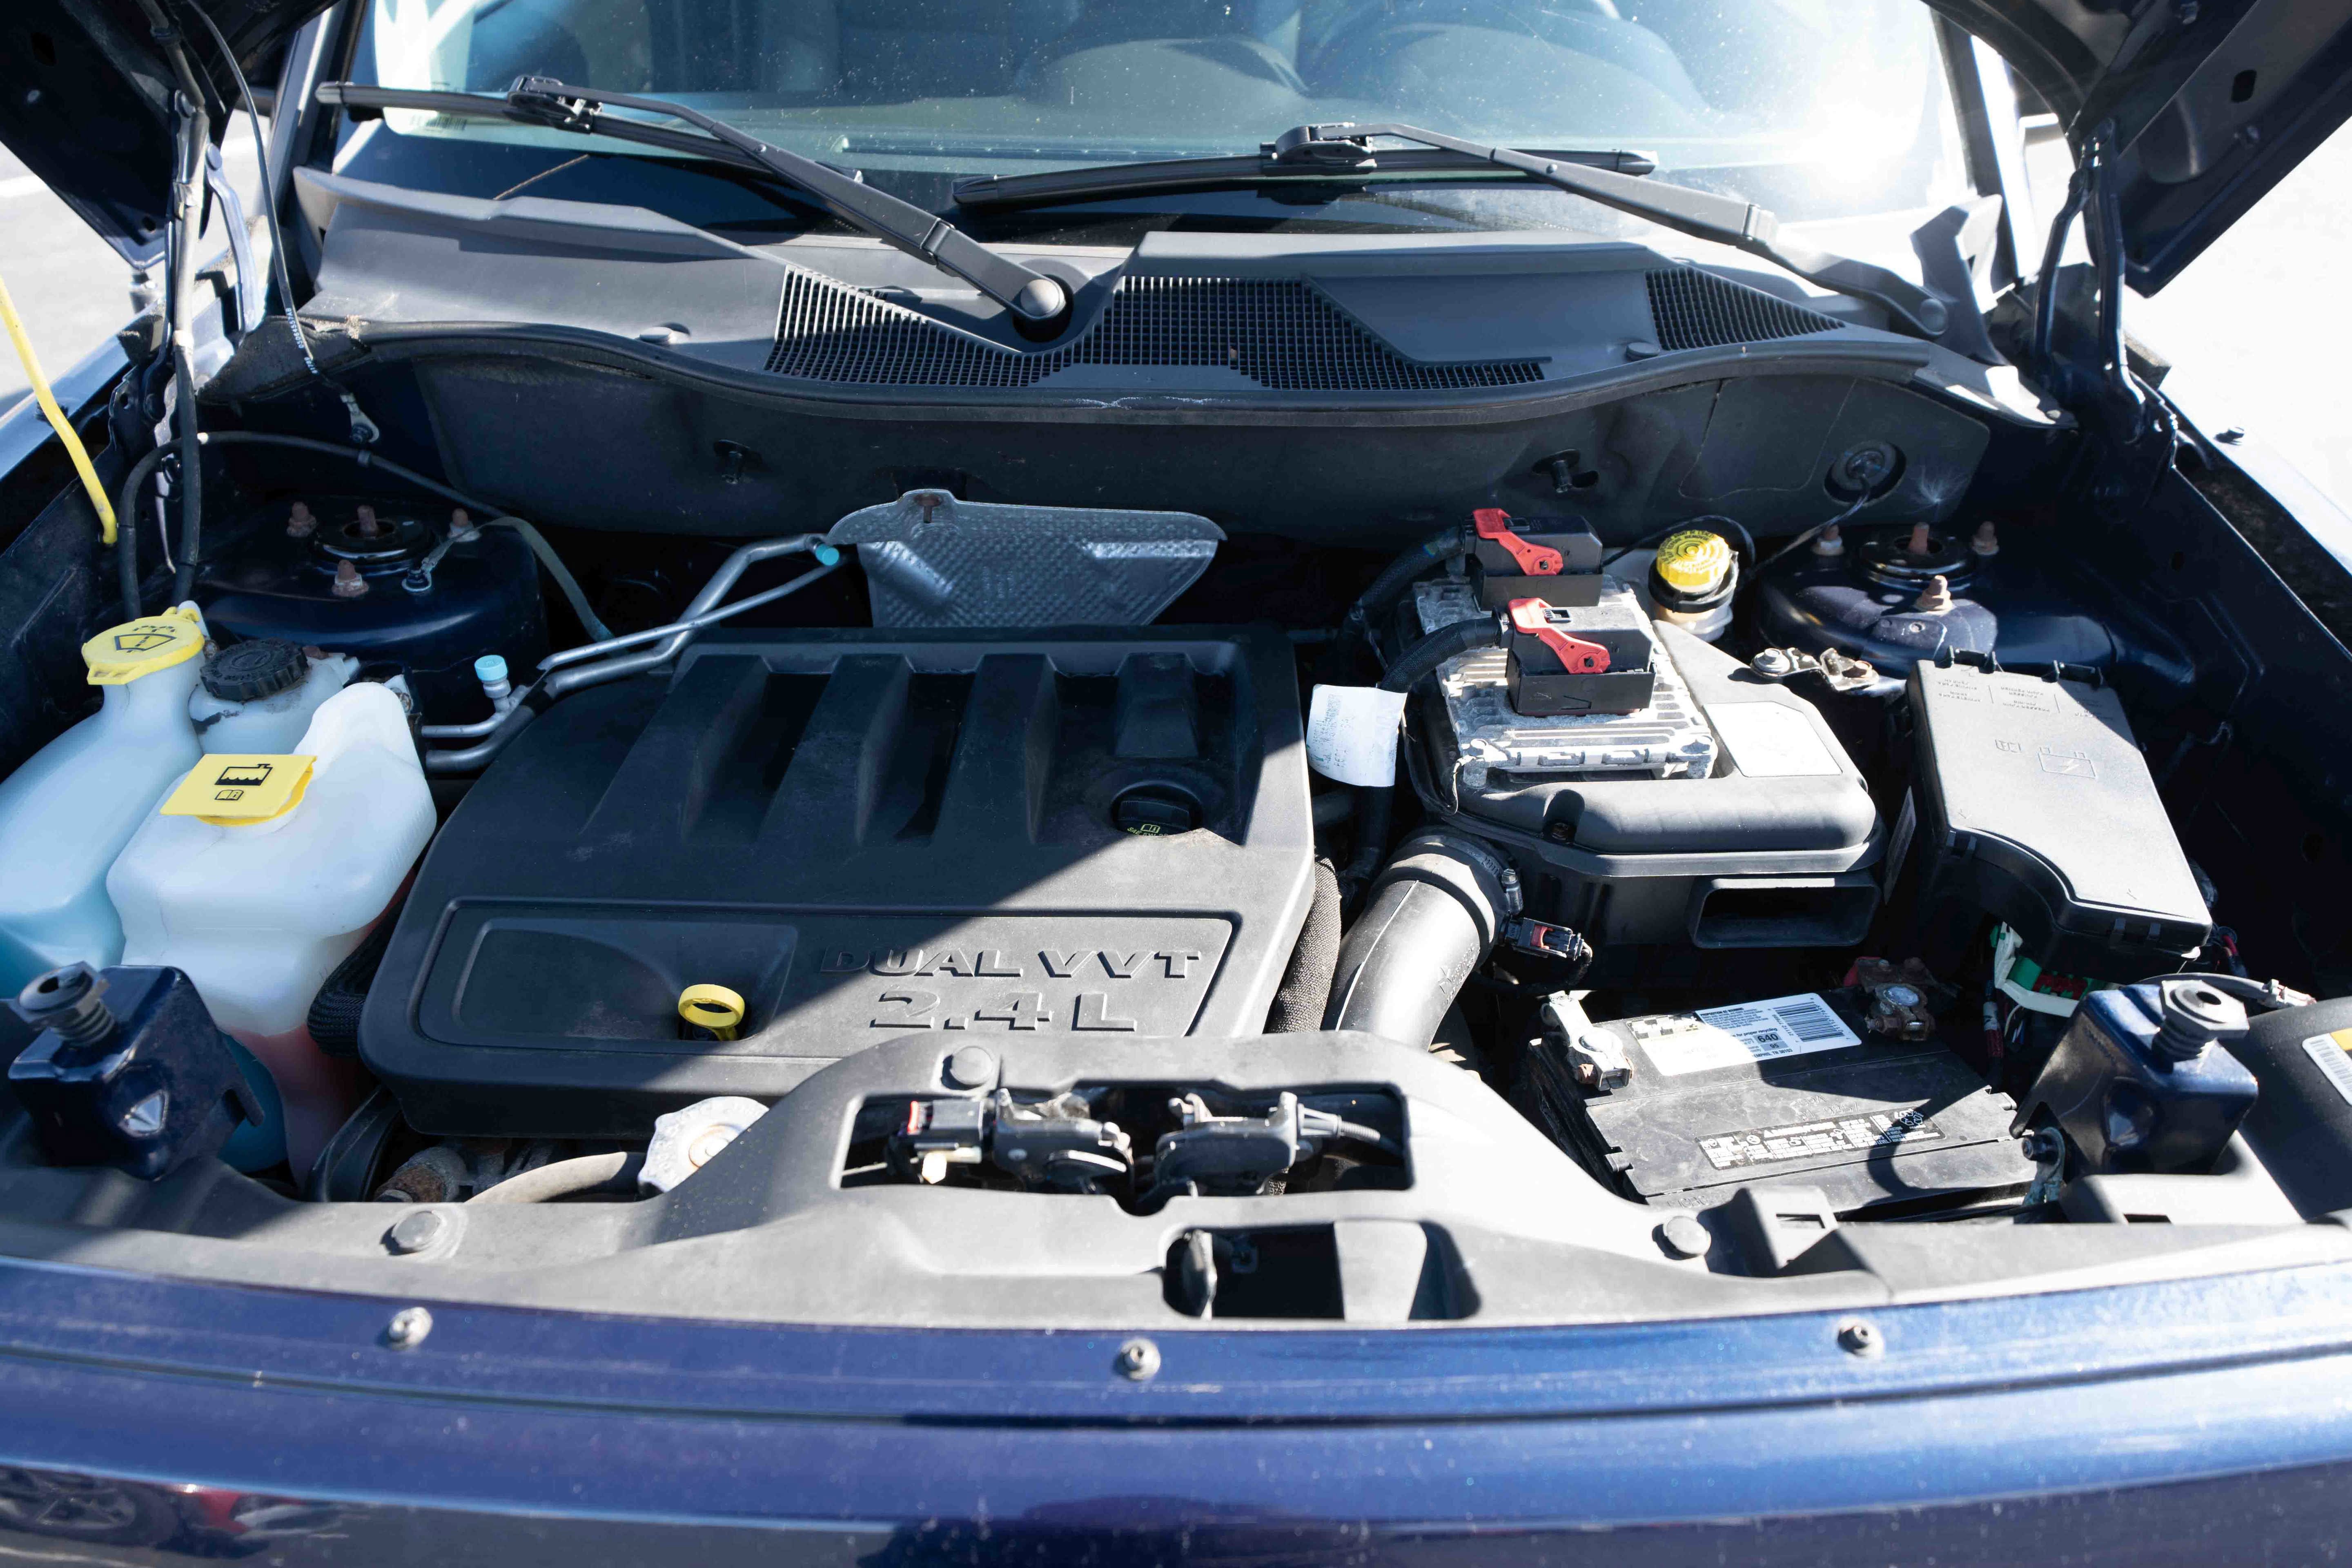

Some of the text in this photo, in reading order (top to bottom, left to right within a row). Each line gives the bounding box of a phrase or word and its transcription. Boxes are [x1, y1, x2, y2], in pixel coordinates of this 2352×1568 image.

[1127, 827, 1142, 835] SAE
[820, 949, 1201, 979] DUAL VVT
[1757, 1033, 1779, 1043] 640
